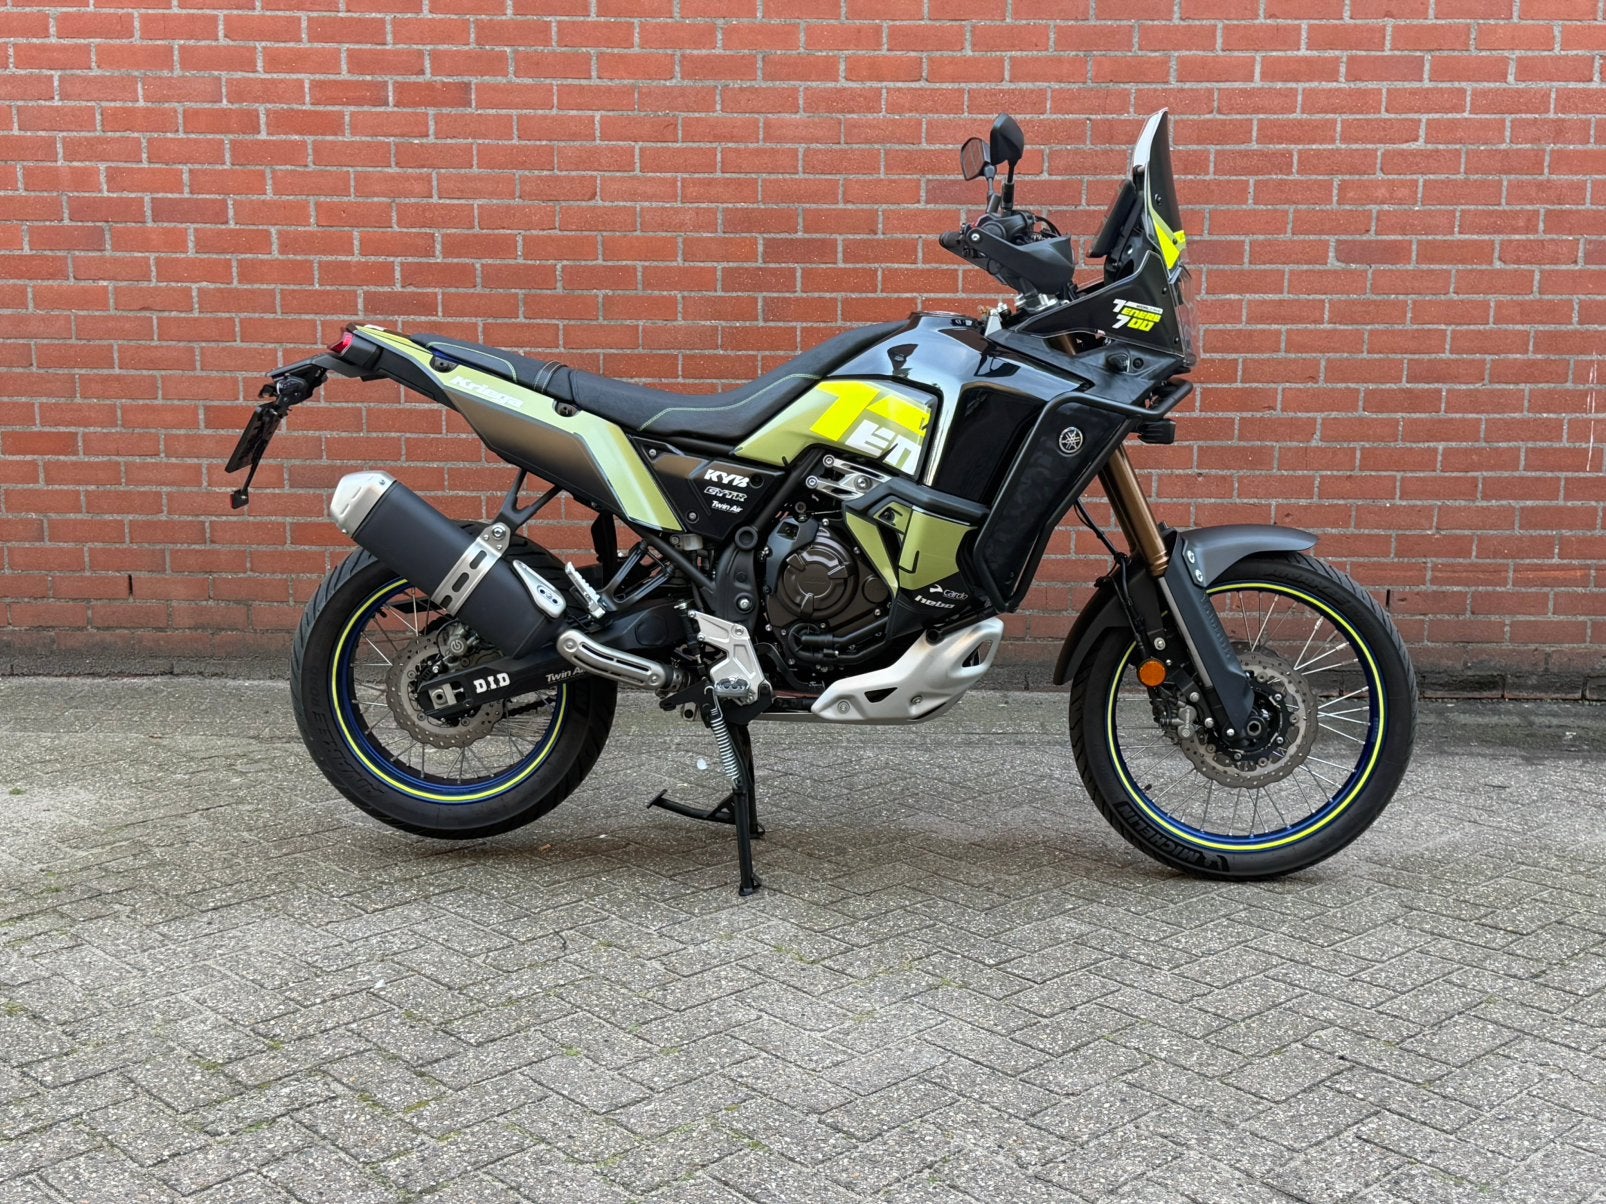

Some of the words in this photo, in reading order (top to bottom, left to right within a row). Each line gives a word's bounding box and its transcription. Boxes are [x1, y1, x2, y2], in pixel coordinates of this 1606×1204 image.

[1112, 313, 1155, 332] 700
[703, 468, 750, 488] KYB
[711, 500, 731, 511] Twin
[730, 504, 744, 513] Air
[545, 670, 571, 682] Twin
[1116, 803, 1203, 862] MICHELIN
